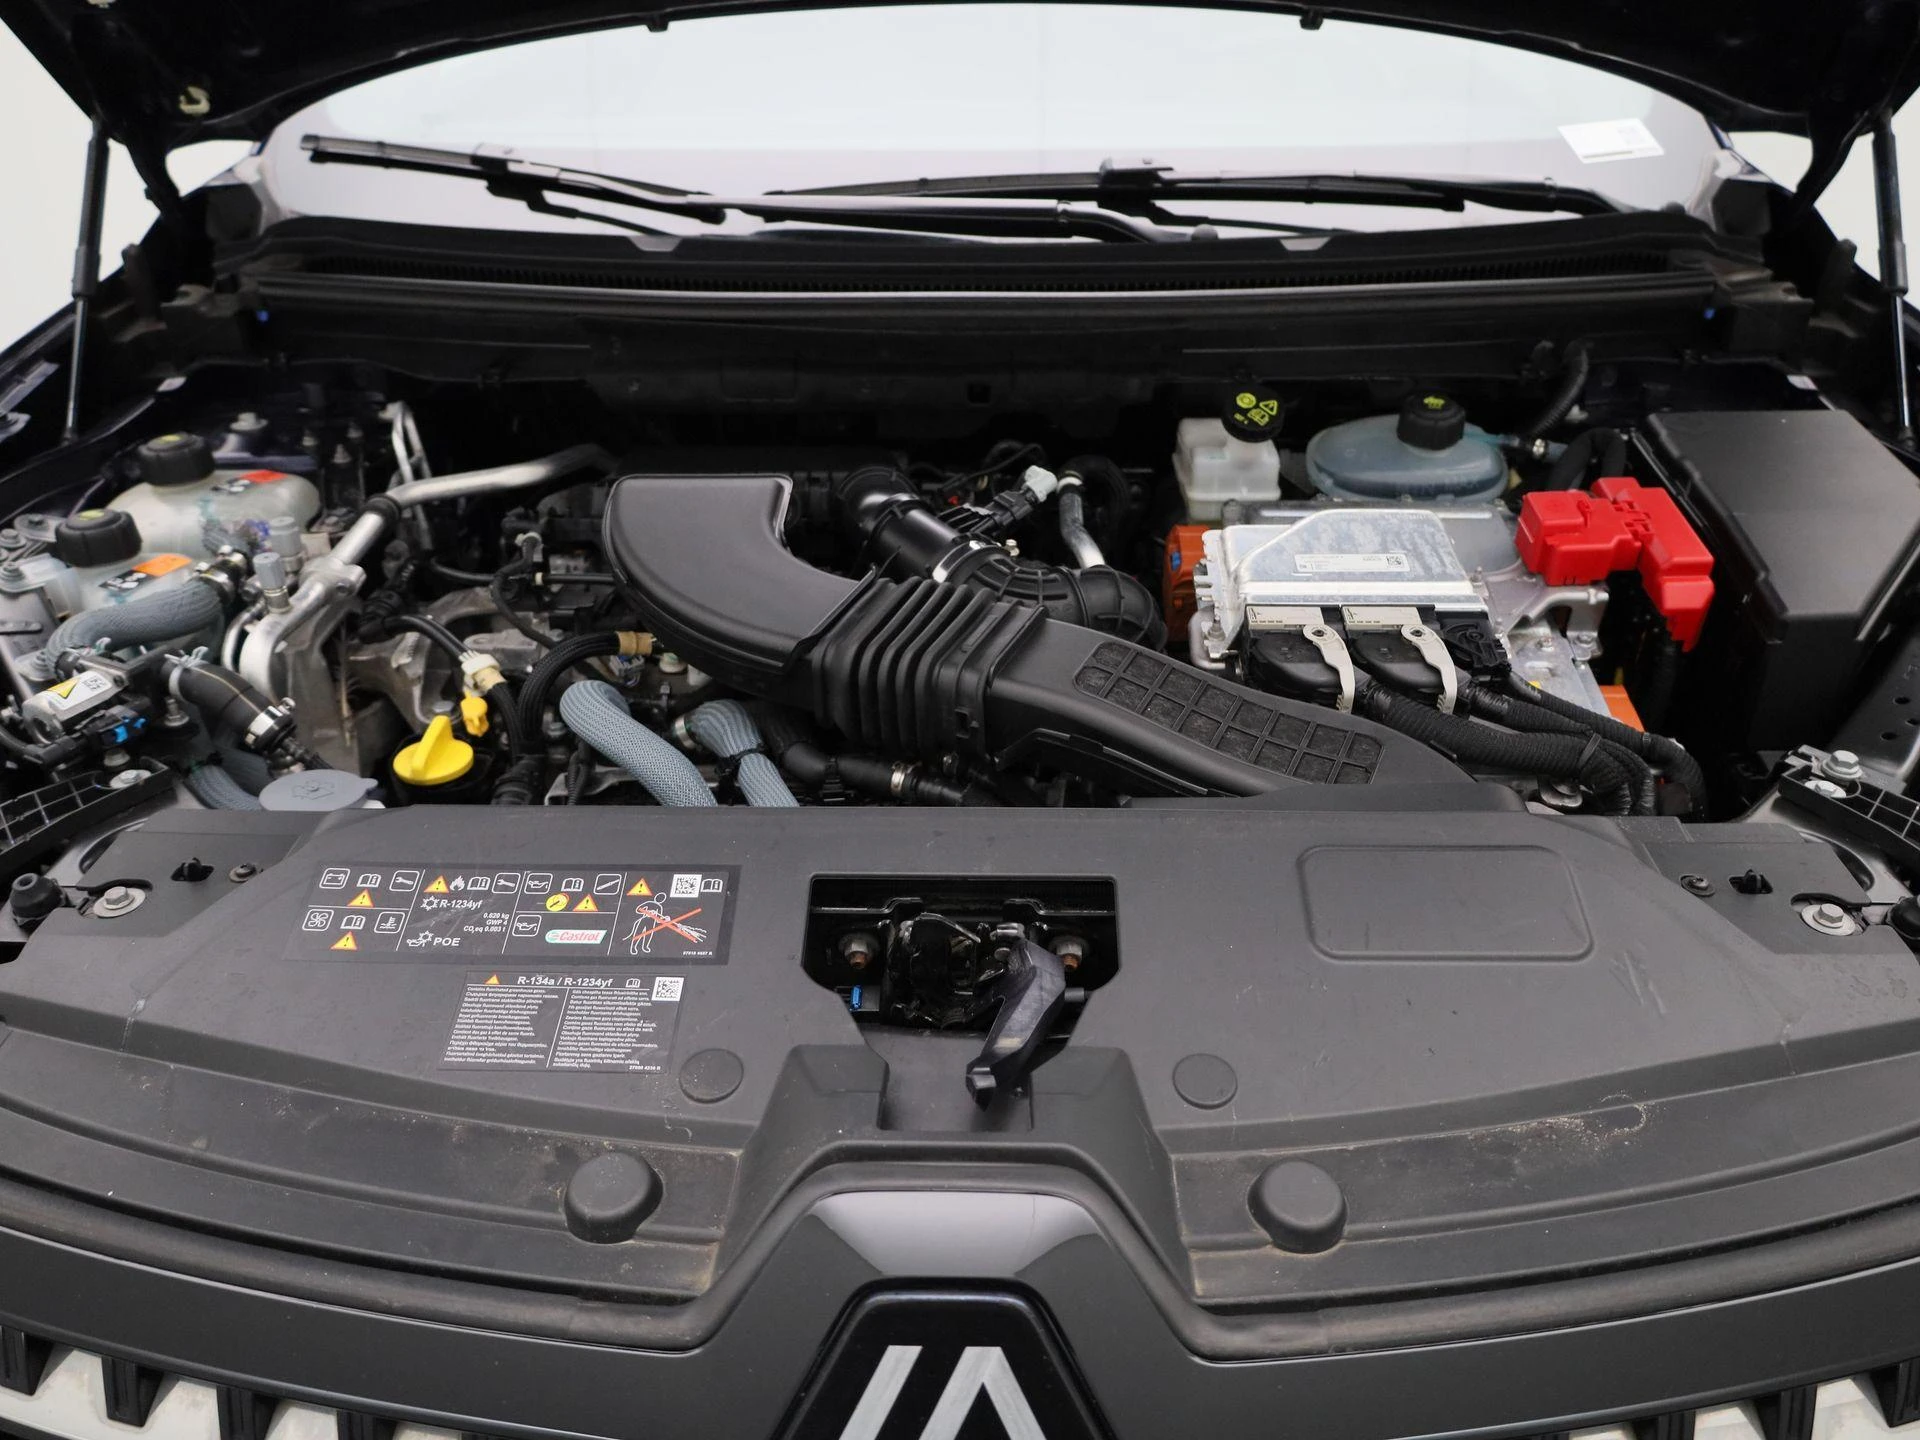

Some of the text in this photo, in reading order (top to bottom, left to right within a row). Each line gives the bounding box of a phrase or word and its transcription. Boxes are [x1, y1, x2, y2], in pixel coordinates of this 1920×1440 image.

[439, 900, 483, 910] R-1234yf
[501, 912, 510, 920] kg
[433, 937, 461, 946] POE
[559, 931, 601, 942] Castrol
[517, 976, 614, 988] R-134a / R-1234yf
